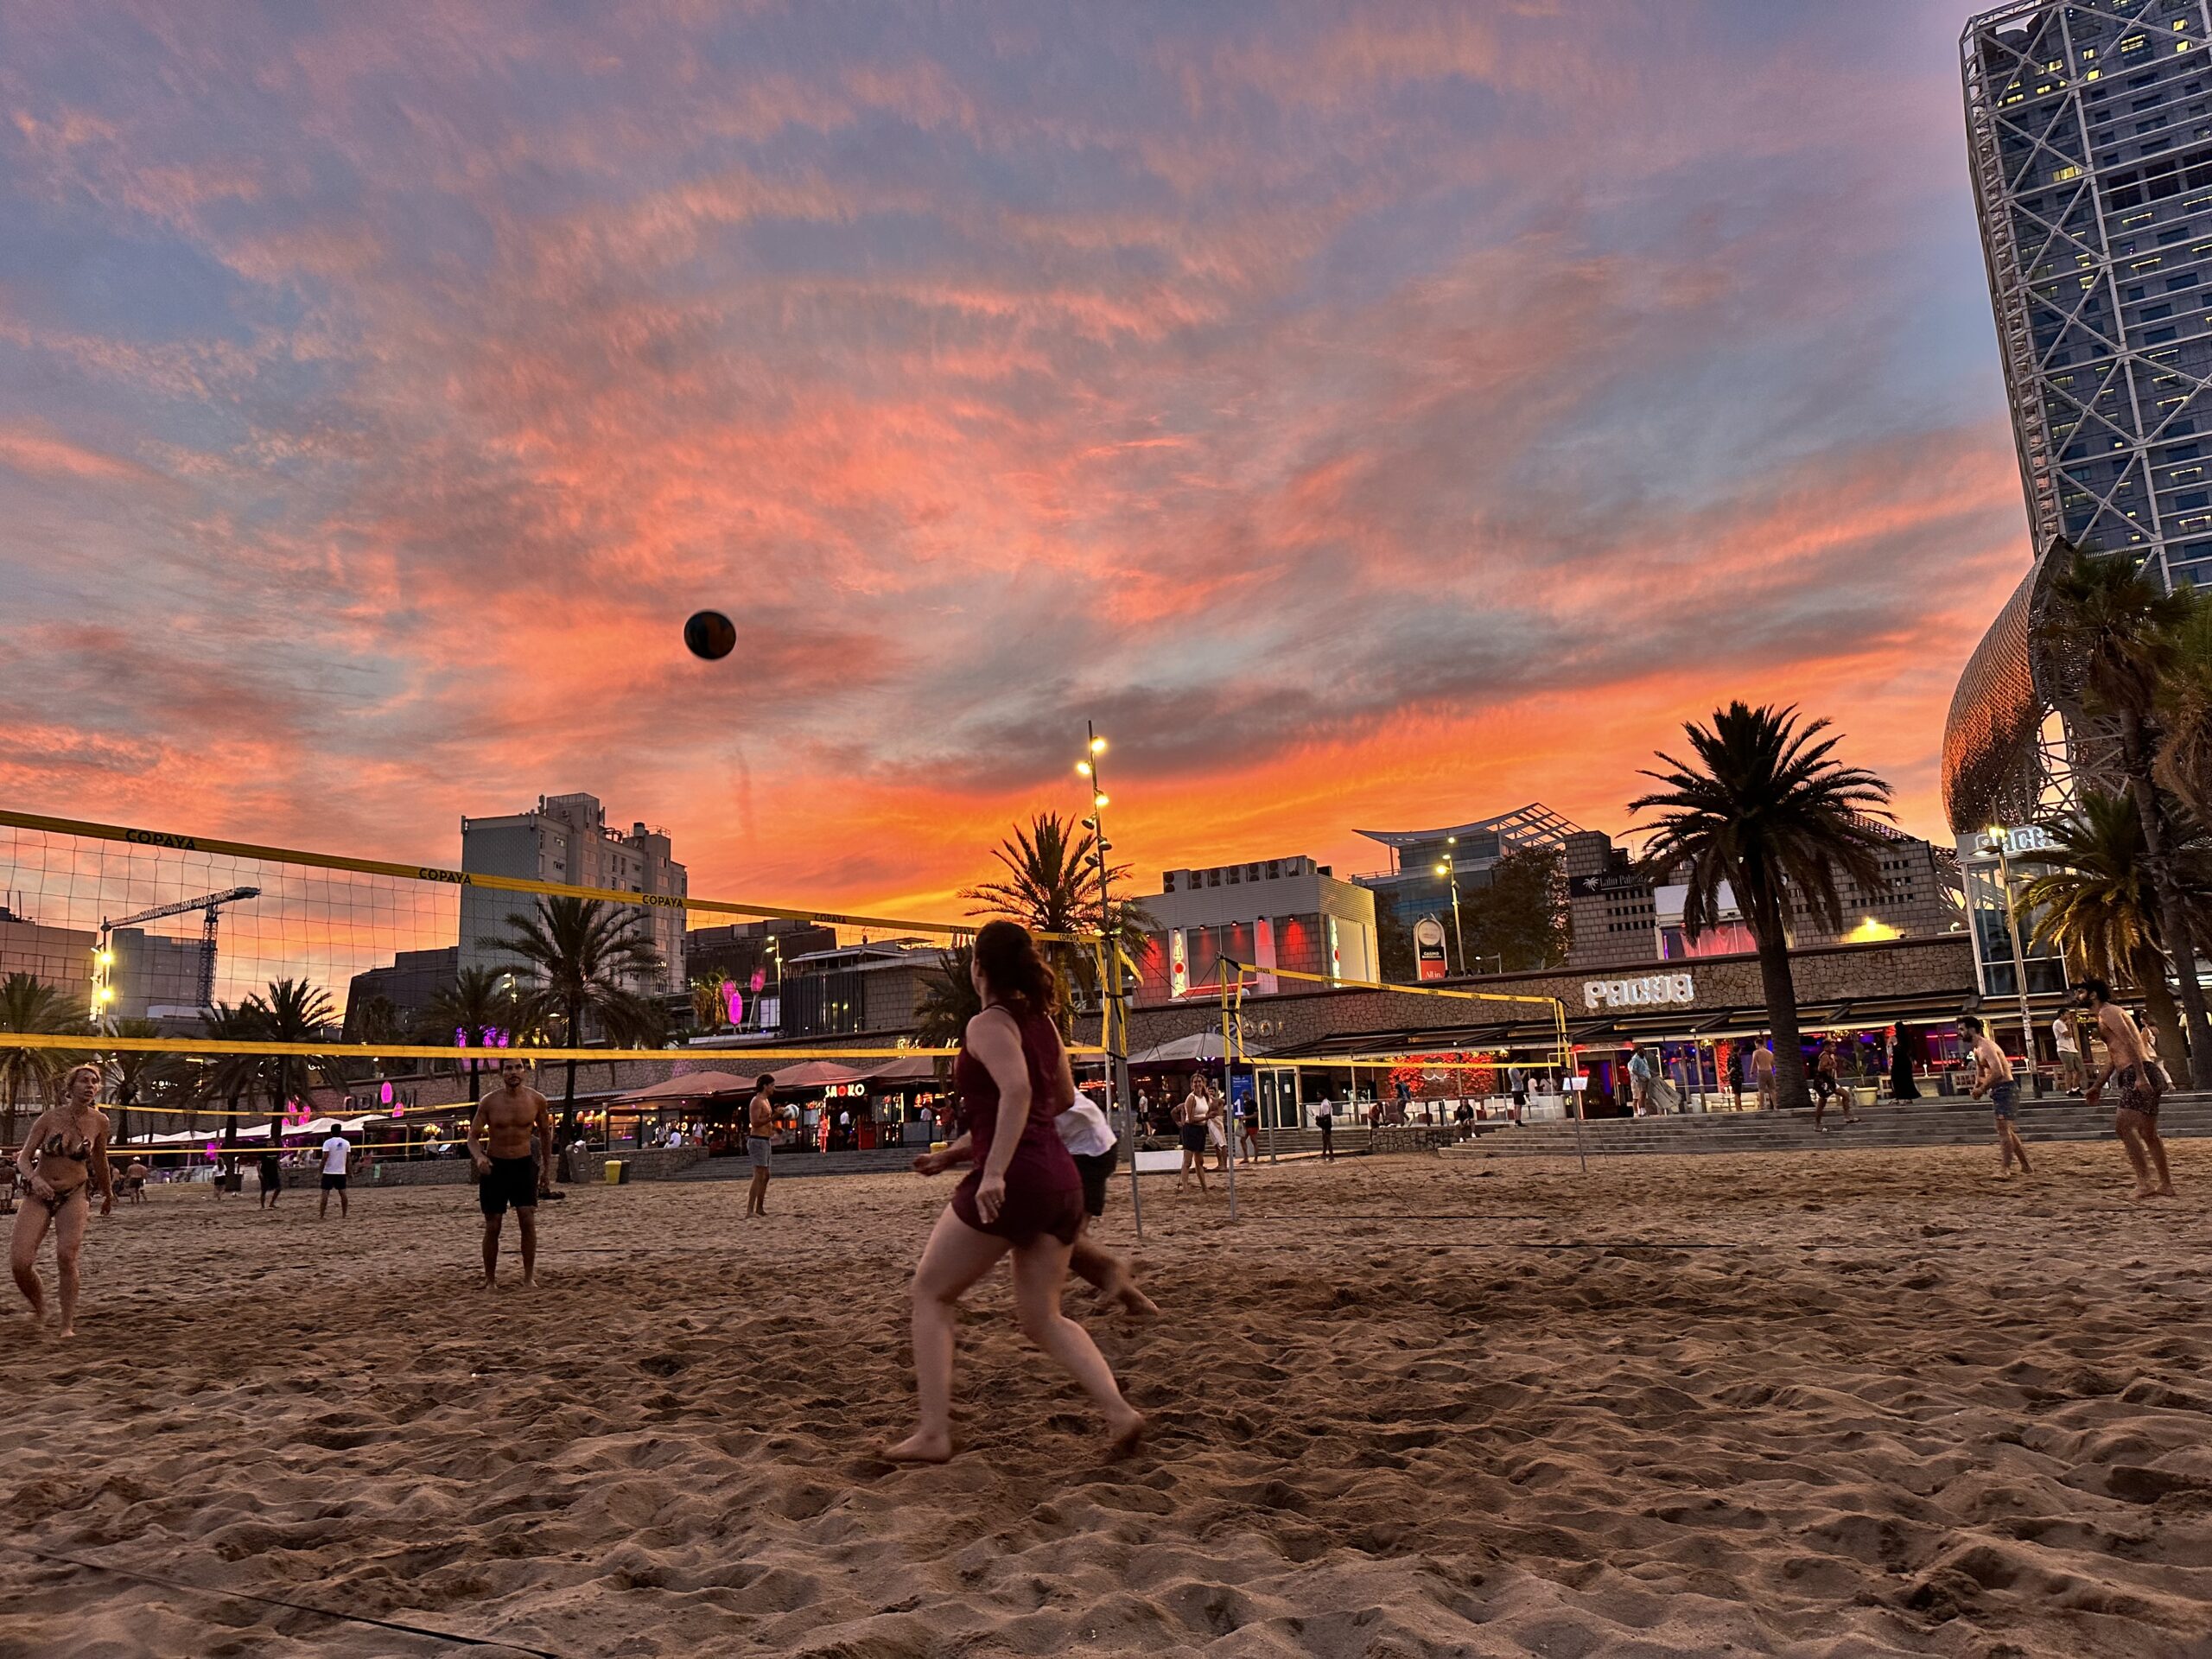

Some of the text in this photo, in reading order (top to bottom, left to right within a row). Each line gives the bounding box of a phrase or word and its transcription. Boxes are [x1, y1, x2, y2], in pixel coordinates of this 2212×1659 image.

[125, 829, 196, 851] COPAYA
[419, 868, 472, 886] COPAYA
[642, 894, 683, 908] COPAYA
[815, 913, 847, 924] COPAYA
[1584, 974, 1694, 1008] PACHA
